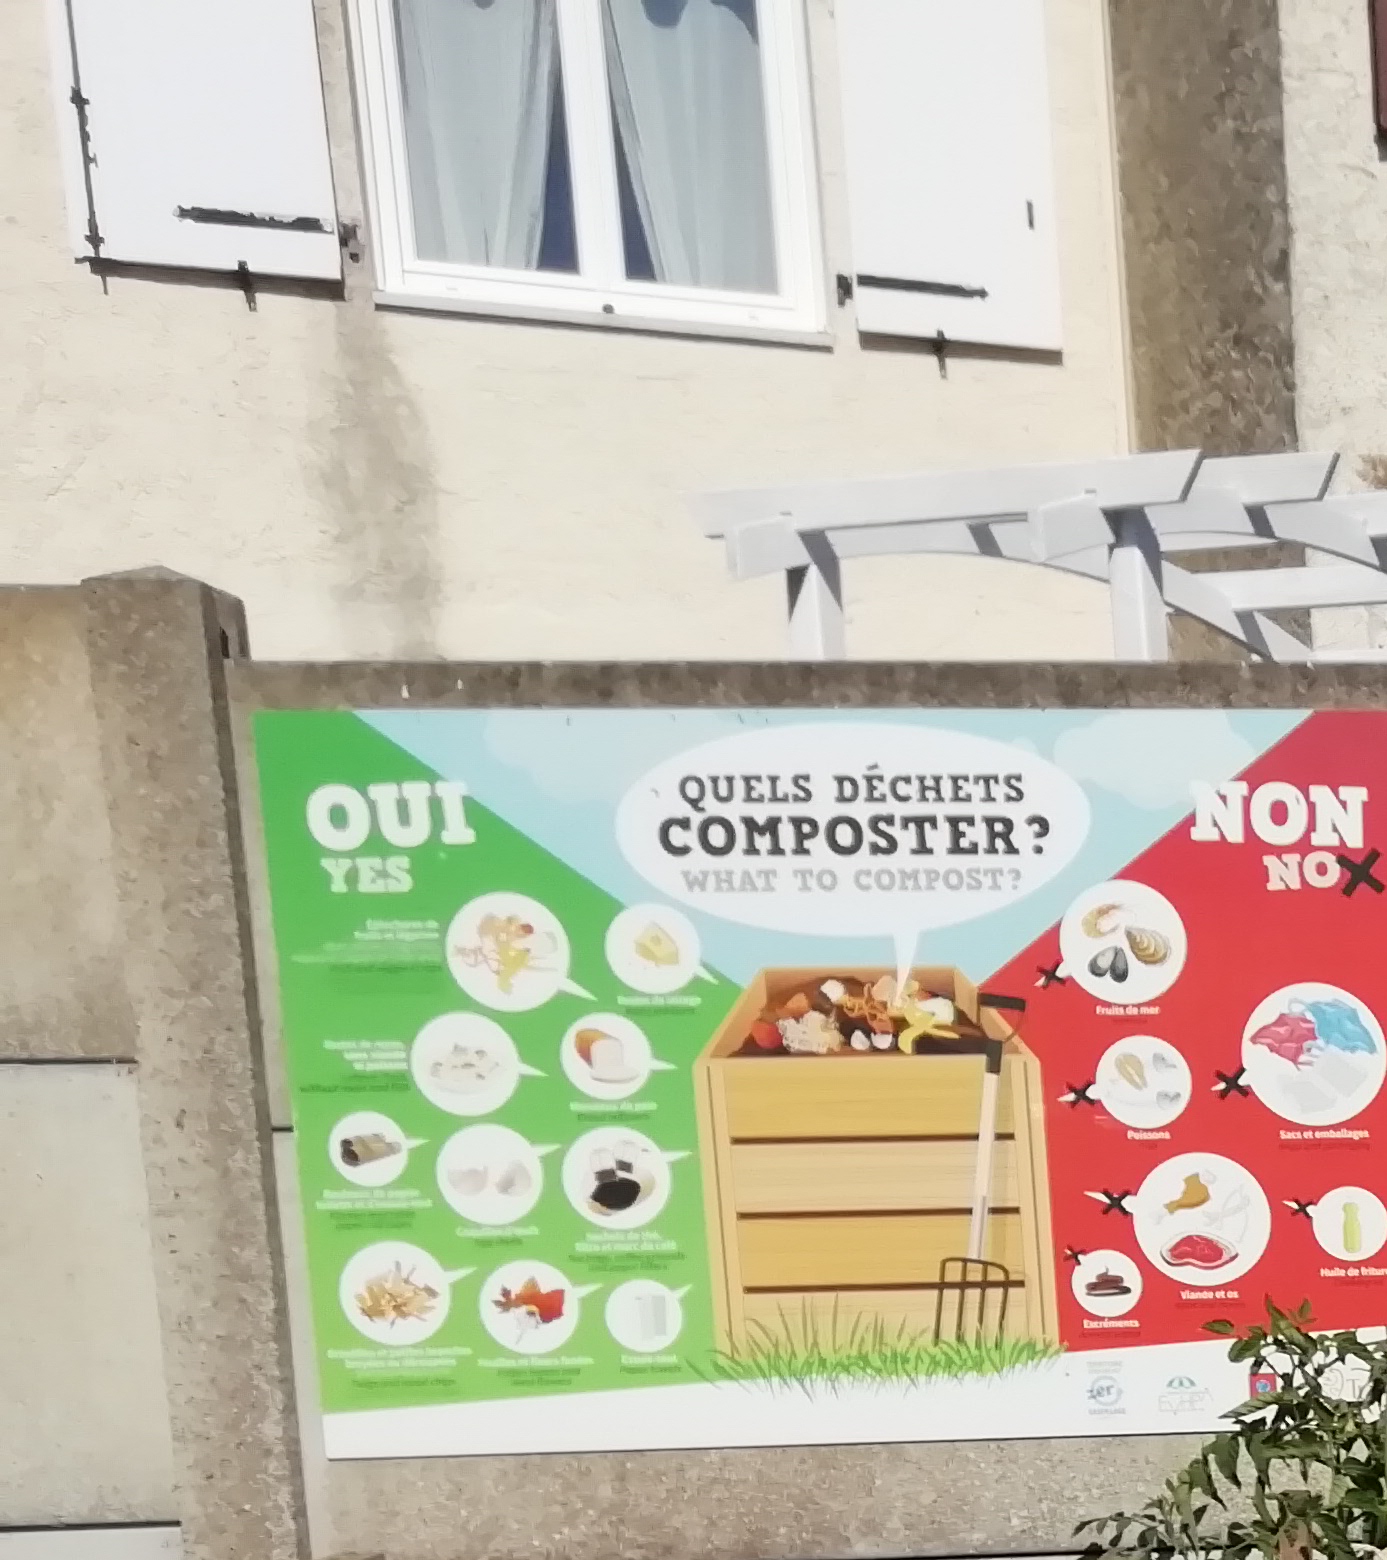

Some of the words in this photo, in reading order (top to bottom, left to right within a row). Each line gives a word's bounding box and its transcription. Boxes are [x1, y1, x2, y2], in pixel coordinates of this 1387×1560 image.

[679, 772, 813, 812] QUELS
[832, 763, 1025, 803] DÉCHETS
[306, 780, 476, 851] OUI
[658, 813, 1050, 857] COMPOSTER?
[1189, 780, 1368, 849] NON
[320, 856, 413, 893] YES
[682, 868, 778, 893] WHAT
[793, 868, 838, 892] TO
[853, 867, 1022, 892] COMPOST?
[1262, 850, 1340, 891] NO
